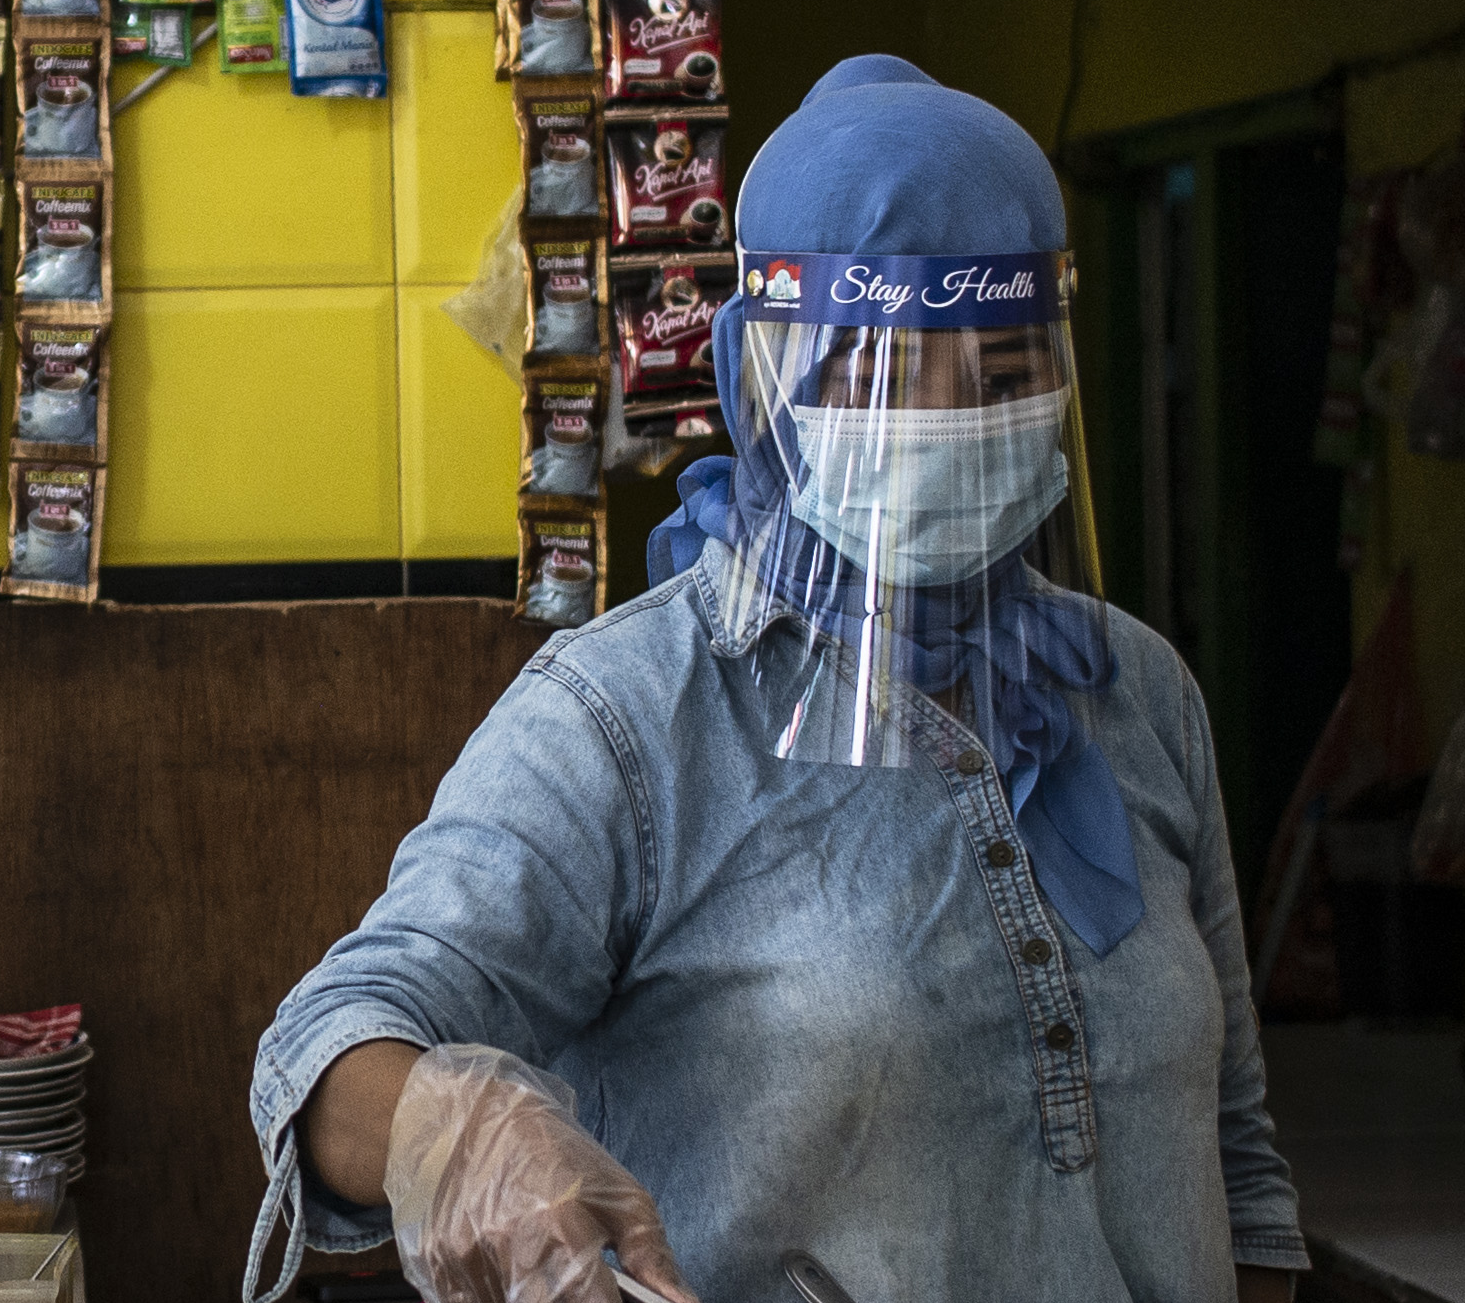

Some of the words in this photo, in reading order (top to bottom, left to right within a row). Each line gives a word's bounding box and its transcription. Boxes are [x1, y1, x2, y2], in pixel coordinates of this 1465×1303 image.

[678, 10, 710, 37] Api
[34, 56, 90, 71] Coffeemix
[682, 157, 713, 183] Api
[36, 199, 92, 214] Coffeemix
[830, 265, 915, 315] Stay
[921, 266, 1036, 308] Health
[540, 535, 590, 549] Coffeemix
